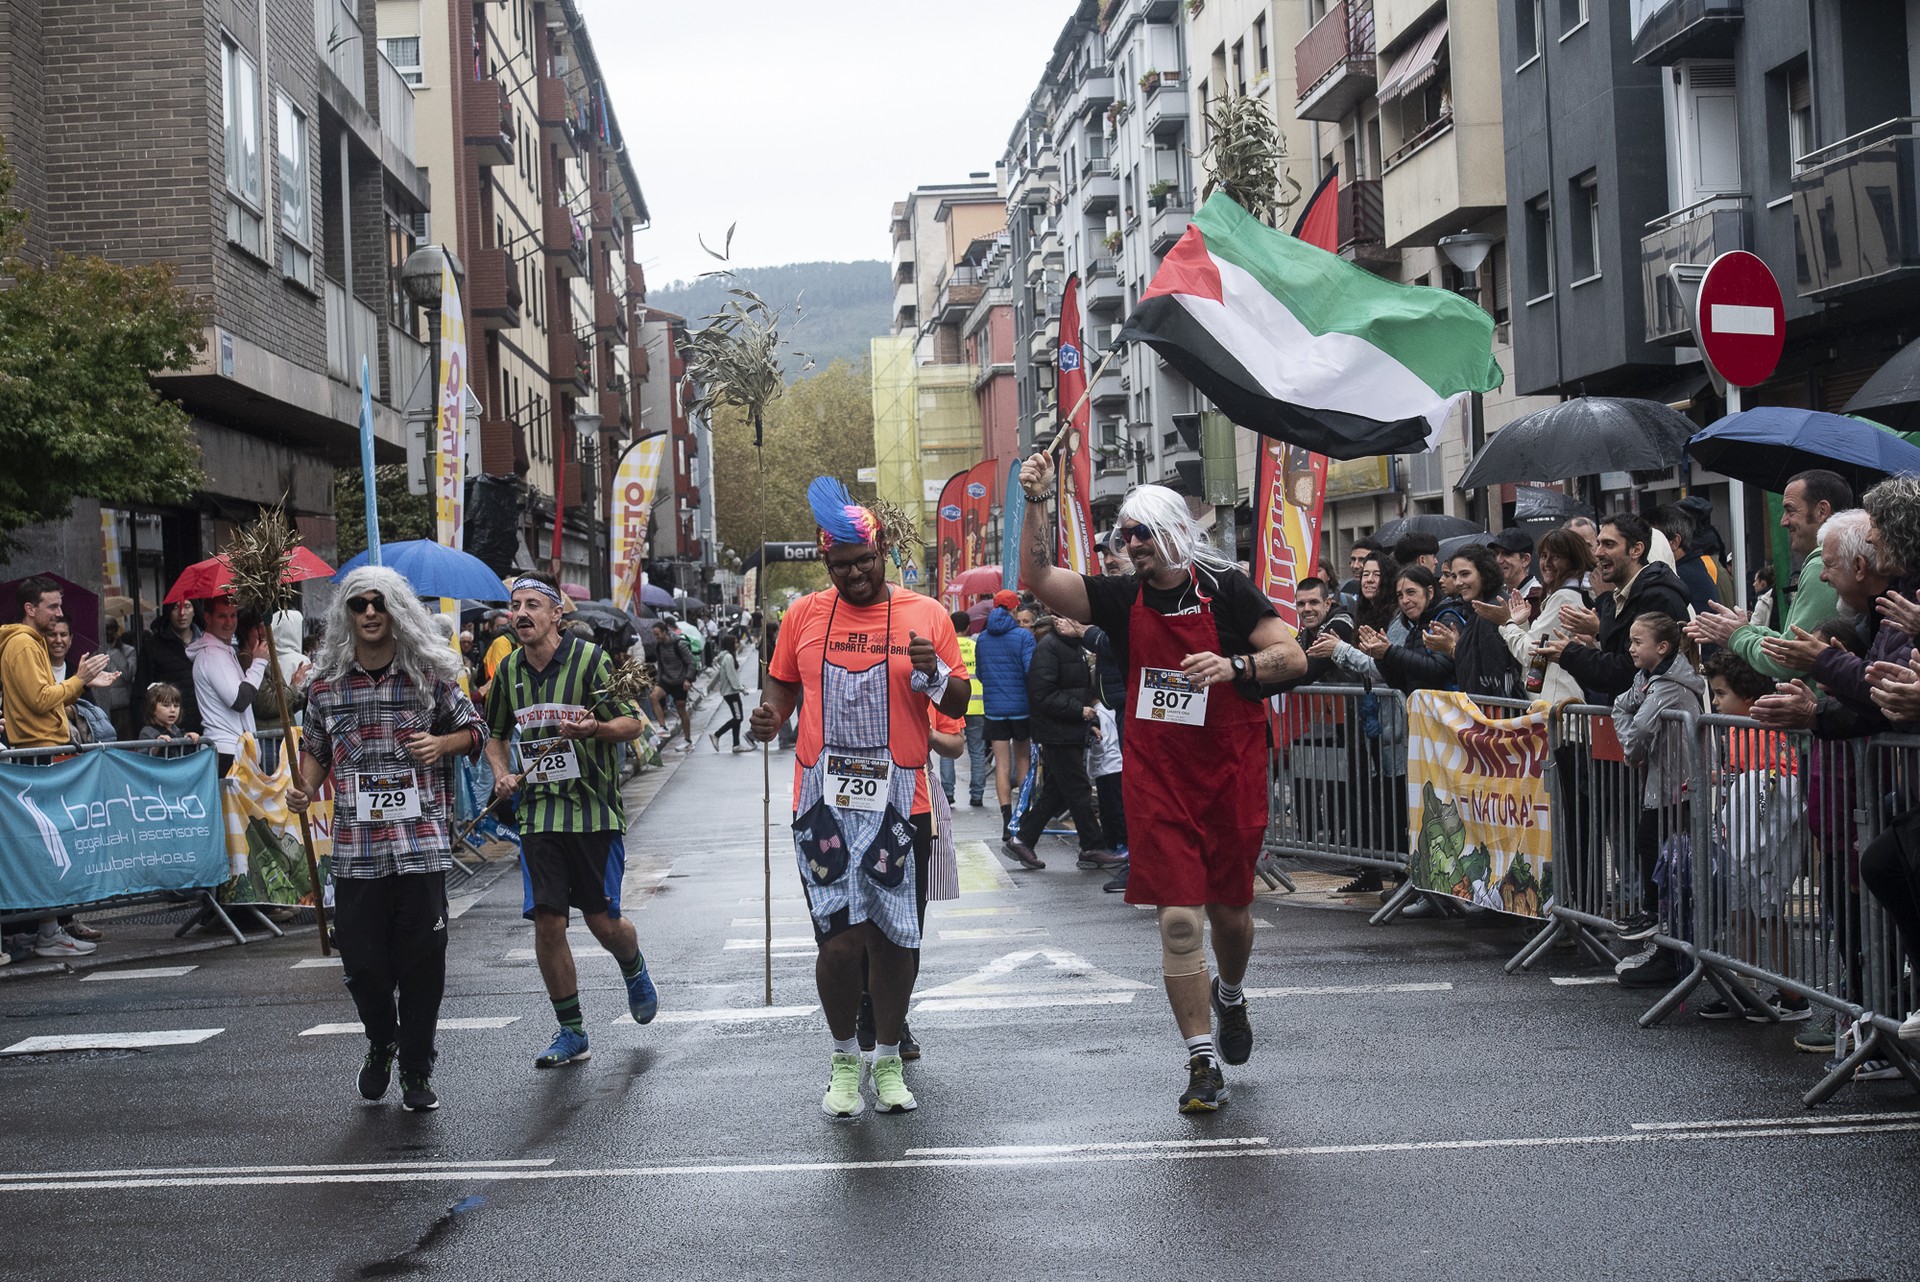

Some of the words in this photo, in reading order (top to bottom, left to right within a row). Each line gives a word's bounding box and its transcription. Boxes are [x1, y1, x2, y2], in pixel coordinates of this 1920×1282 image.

[848, 632, 868, 643] 28
[1152, 690, 1193, 710] 807
[1458, 720, 1549, 779] ANETO
[532, 755, 567, 771] 728
[837, 776, 877, 797] 730
[61, 784, 206, 831] bertako
[368, 791, 406, 808] 729
[74, 829, 130, 854] igogailuak
[138, 825, 210, 842] ascensores
[85, 850, 196, 875] www.bertako.eus
